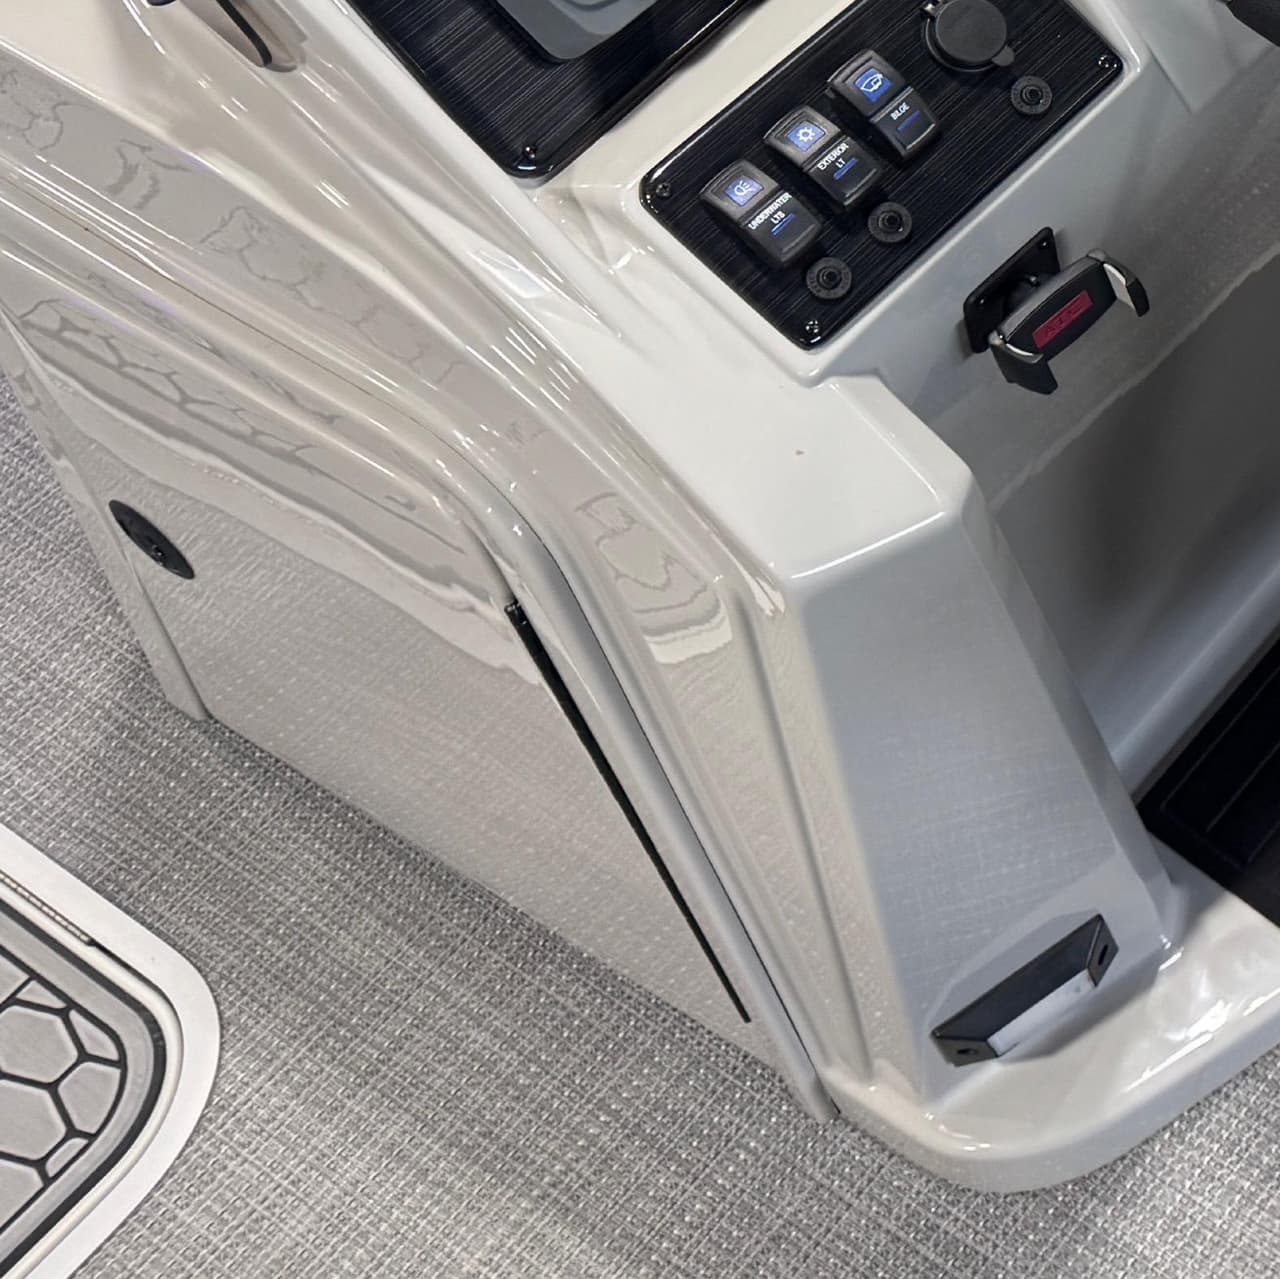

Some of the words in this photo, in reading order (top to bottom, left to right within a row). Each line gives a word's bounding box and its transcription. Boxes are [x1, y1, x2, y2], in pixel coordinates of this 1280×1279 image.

[817, 142, 849, 171] EXTERIOR
[835, 159, 846, 168] LT
[748, 191, 792, 230] UNDERWATER
[771, 210, 786, 224] LTS
